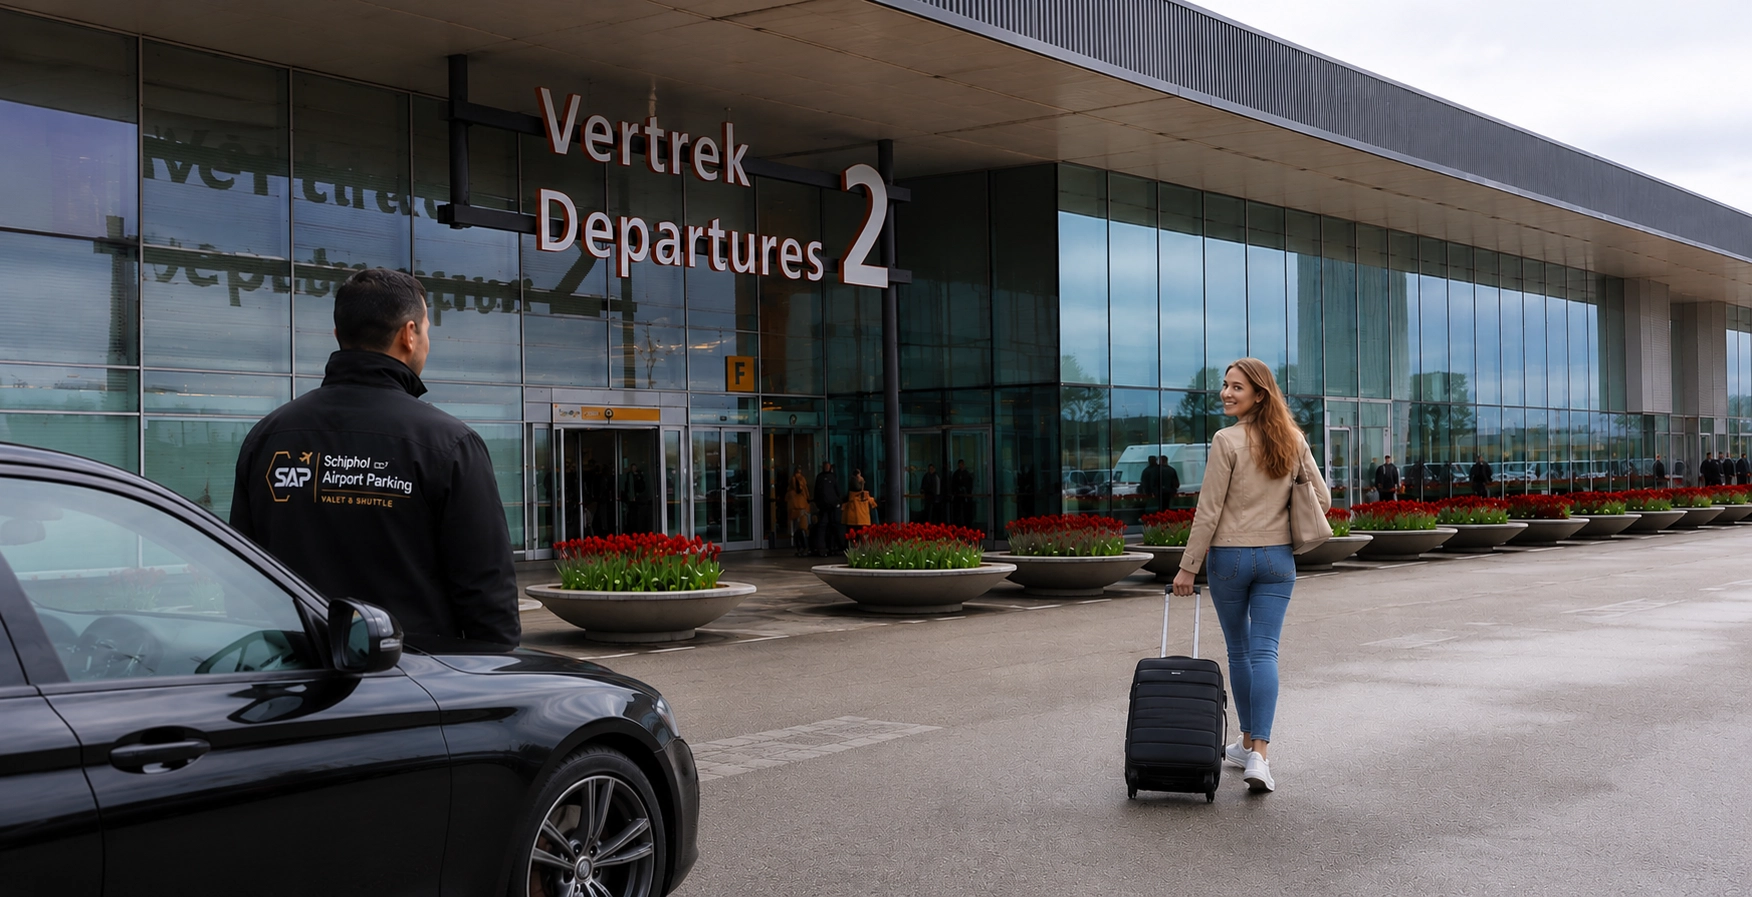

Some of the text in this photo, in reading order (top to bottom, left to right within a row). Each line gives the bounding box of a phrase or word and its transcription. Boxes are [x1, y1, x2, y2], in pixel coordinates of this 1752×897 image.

[535, 86, 751, 187] Vertrek
[535, 188, 824, 278] Departures
[839, 163, 889, 288] 2
[735, 362, 745, 385] F
[324, 455, 371, 470] Schiphol
[274, 467, 312, 487] SAP
[322, 470, 413, 494] Airport Parking
[321, 495, 346, 504] VALET
[356, 497, 393, 508] SHUTTLE
